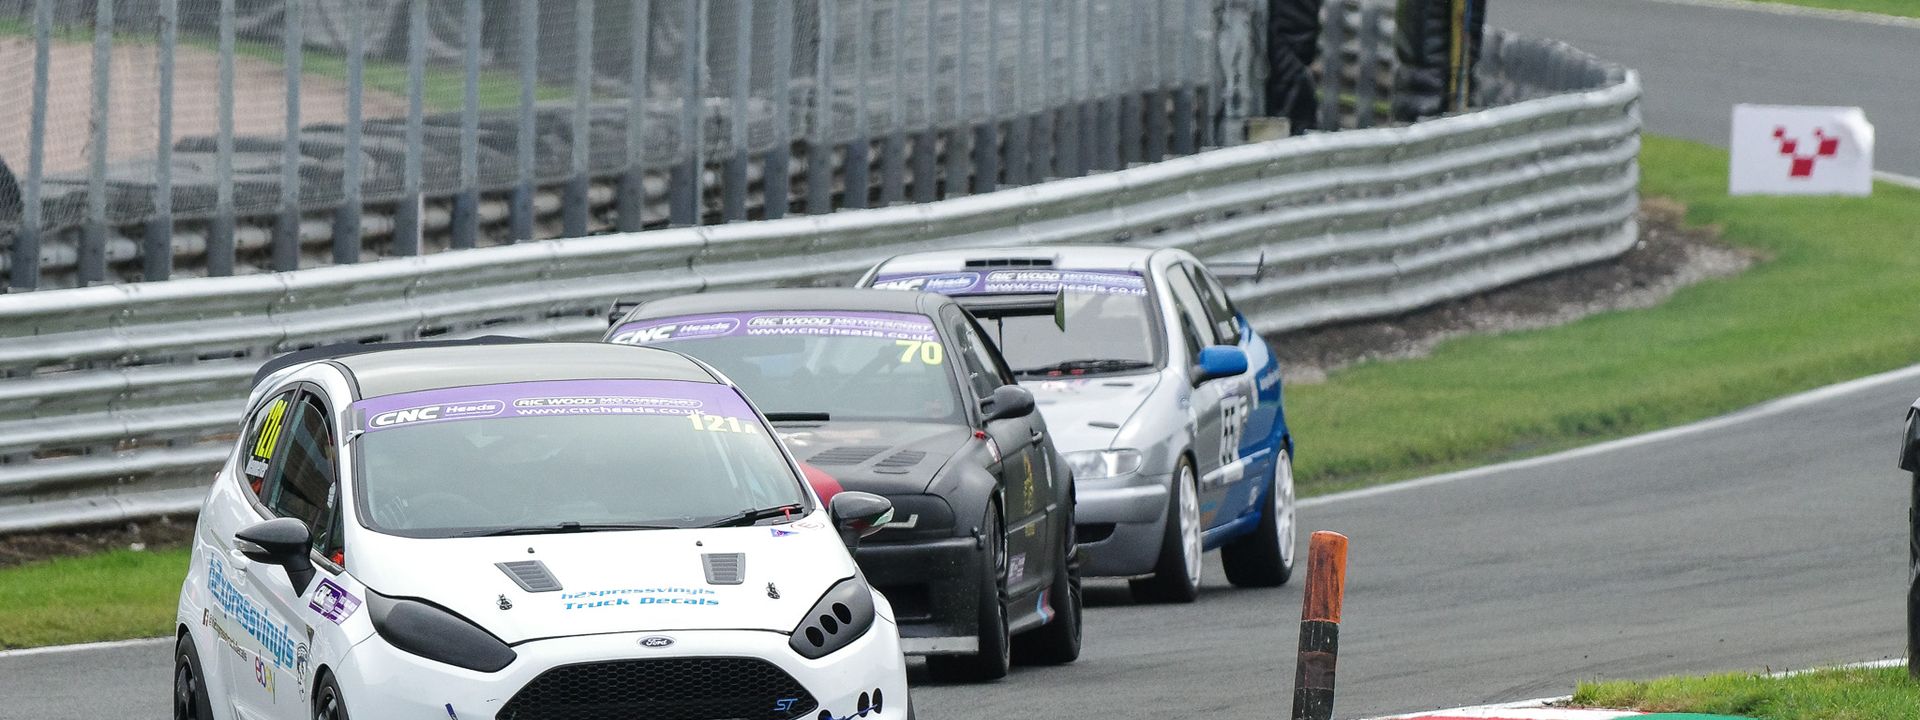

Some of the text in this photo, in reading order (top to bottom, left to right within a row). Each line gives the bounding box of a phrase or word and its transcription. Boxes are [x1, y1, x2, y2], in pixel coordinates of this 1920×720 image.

[1017, 272, 1060, 281] WOOD
[985, 281, 1149, 296] www.cncheads.co.uk
[754, 317, 779, 326] RIC
[782, 317, 831, 326] WOOD
[612, 321, 730, 343] CNC Heads
[747, 326, 935, 341] www.cncheads.co.uk
[896, 339, 943, 365] 70
[519, 398, 546, 406] RIC
[548, 397, 596, 406] WOOD
[376, 406, 440, 426] CNC
[446, 403, 496, 413] Heads
[516, 405, 705, 416] www.cncheads.co.uk
[564, 596, 719, 610] Truck Decals
[645, 637, 668, 647] Ford
[773, 698, 798, 712] ST
